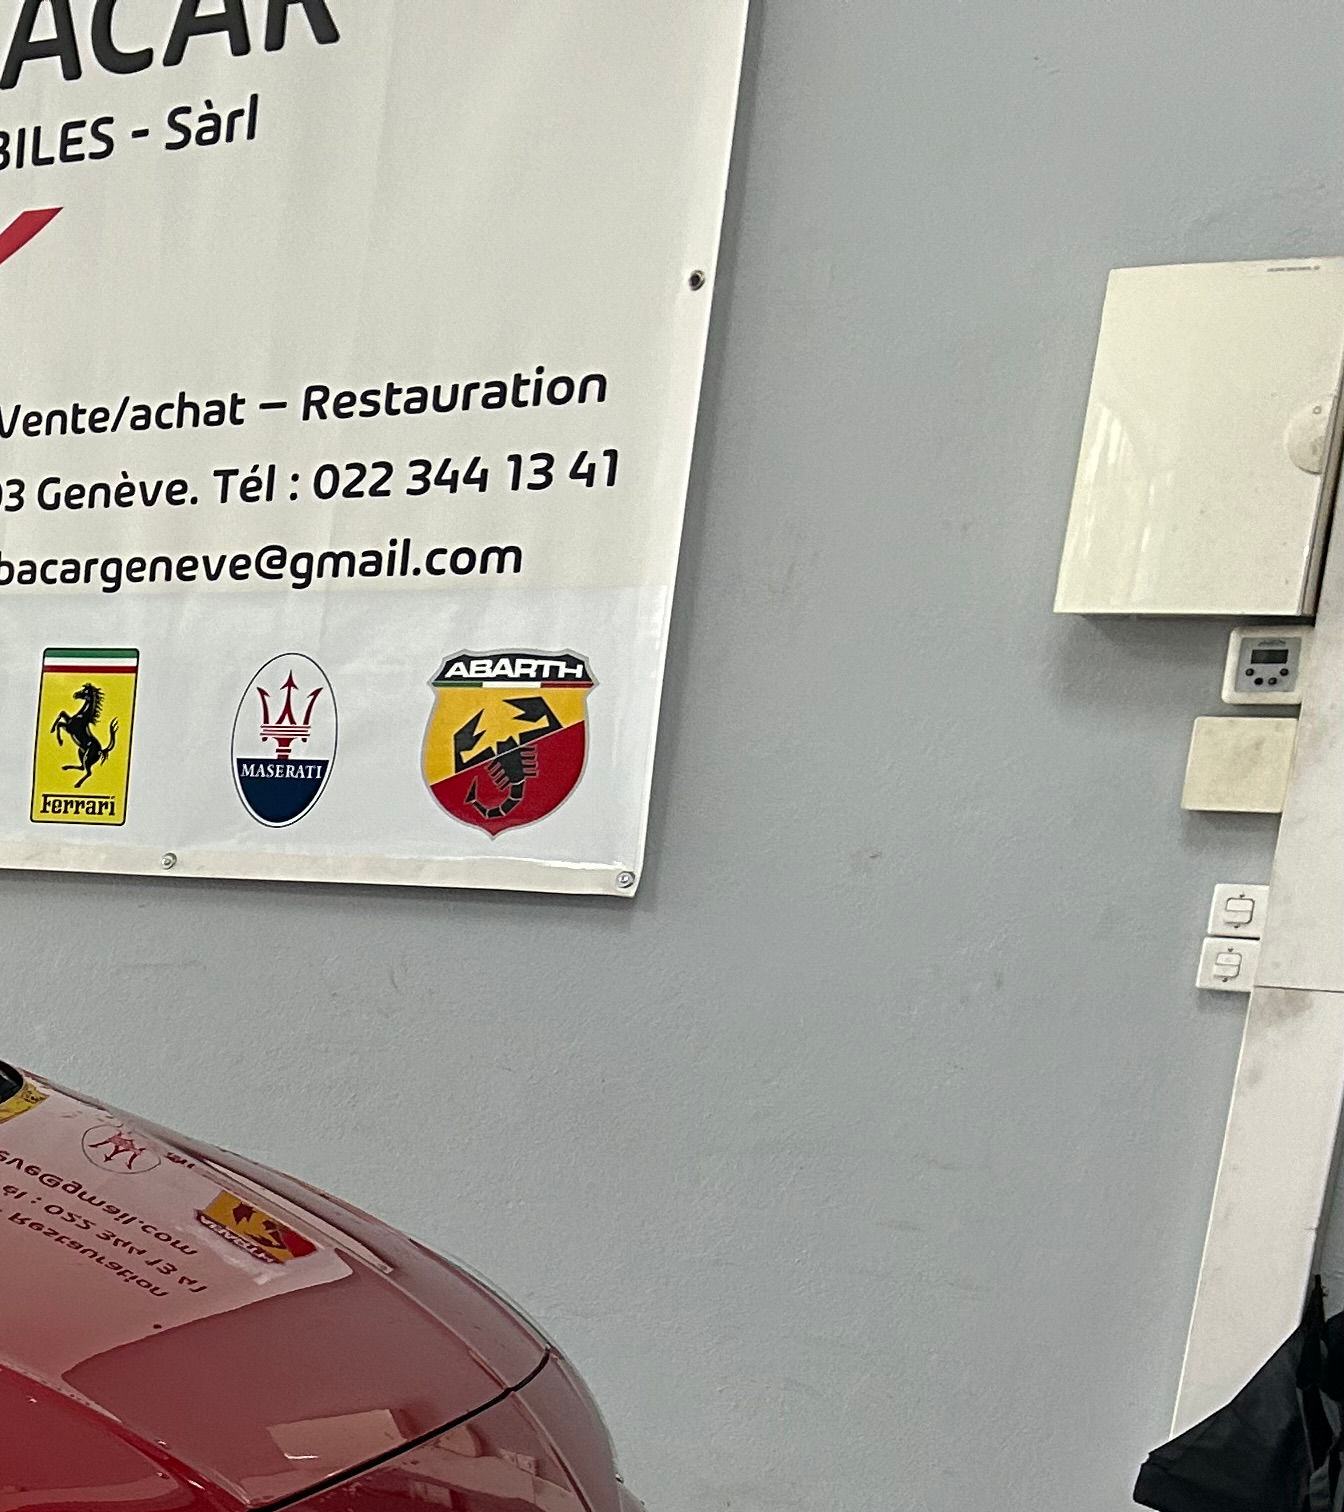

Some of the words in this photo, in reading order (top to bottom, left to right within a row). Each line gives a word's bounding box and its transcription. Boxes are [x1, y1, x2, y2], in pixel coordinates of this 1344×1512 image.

[164, 93, 260, 150] Sàrl
[302, 365, 608, 421] Restauration
[37, 470, 199, 513] Genève.
[213, 463, 276, 504] Tél
[312, 460, 393, 500] 022
[404, 455, 490, 496] 344
[506, 451, 555, 491] 13
[568, 447, 620, 488] 41
[444, 660, 584, 680] ABARTH
[240, 763, 322, 779] MASERATI
[39, 794, 117, 818] Ferrari
